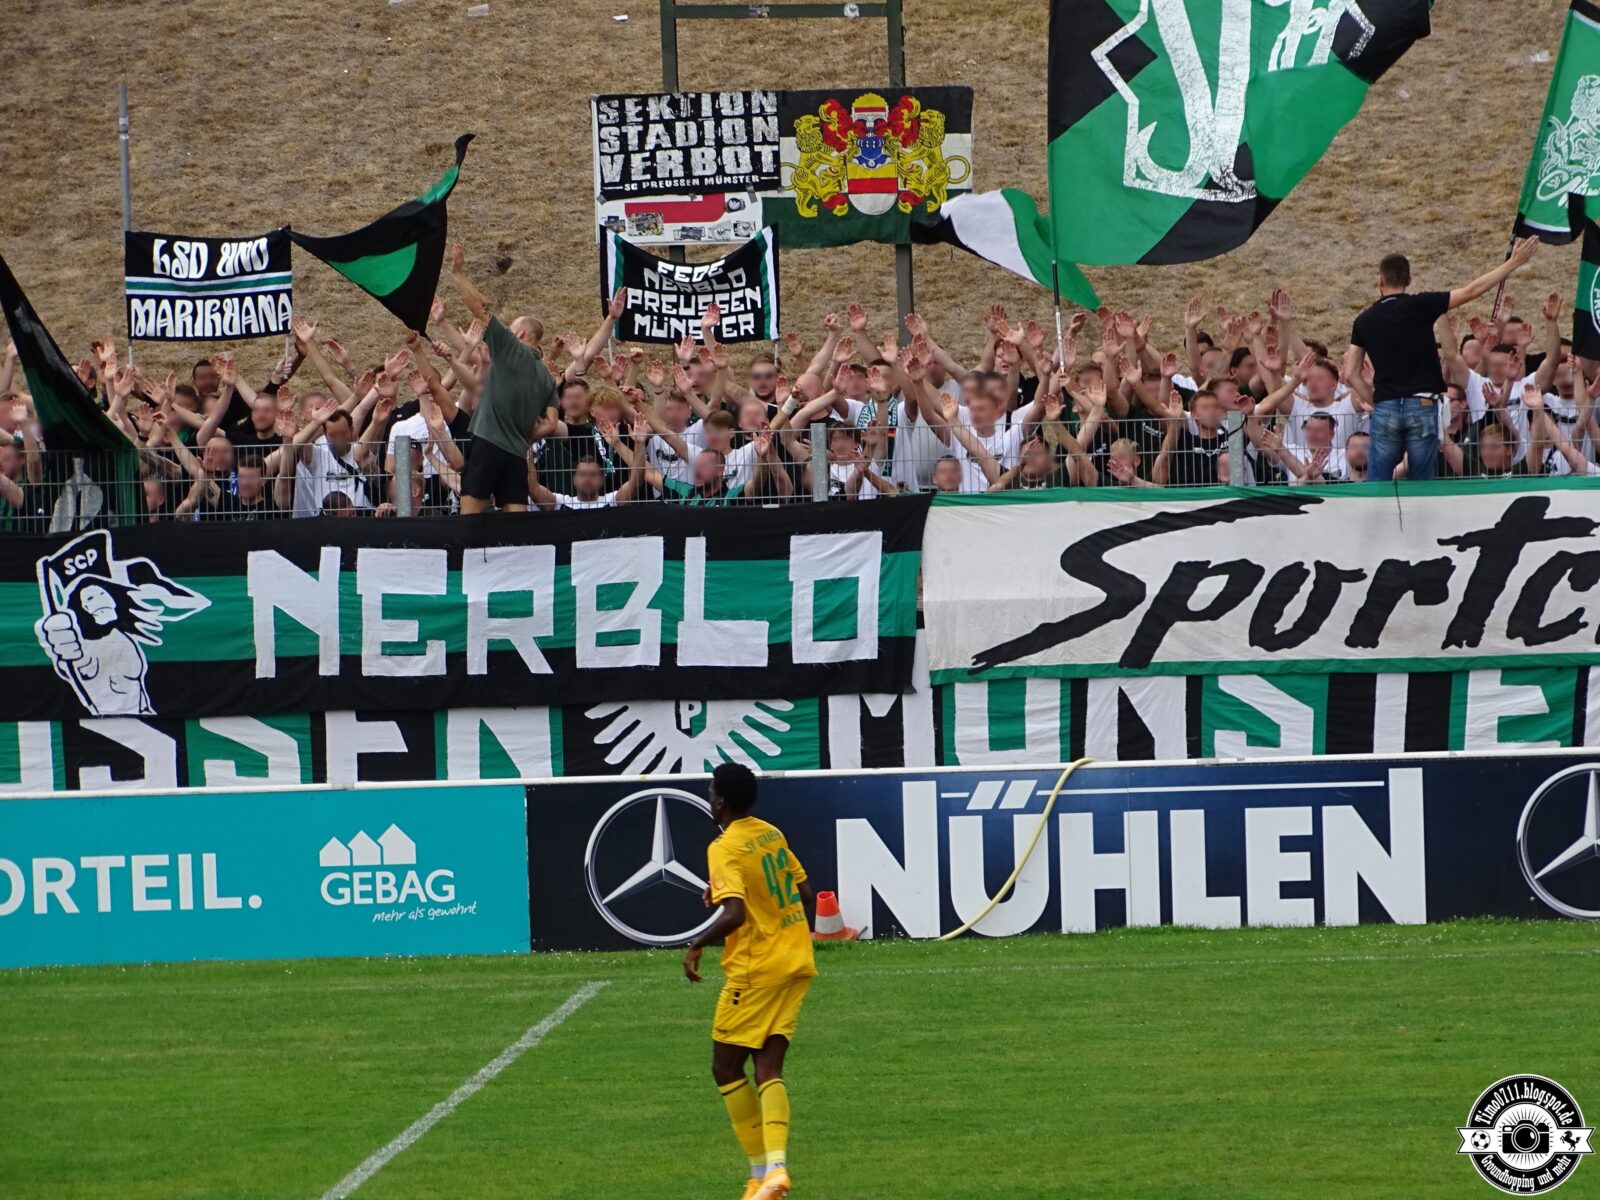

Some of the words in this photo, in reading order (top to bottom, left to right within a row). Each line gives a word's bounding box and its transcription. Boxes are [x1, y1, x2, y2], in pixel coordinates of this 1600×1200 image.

[599, 91, 777, 125] SEKTION
[600, 115, 779, 154] STADION
[601, 145, 779, 184] VERBOT
[642, 178, 700, 189] PREUSSEN
[704, 175, 760, 186] MÜNSTER
[153, 238, 208, 279] LSD
[657, 259, 726, 283] FEDE
[643, 267, 747, 293] NERBLO
[627, 286, 762, 316] PREUSSEN
[63, 548, 98, 576] SCP
[967, 494, 1600, 674] Sportc
[246, 529, 882, 679] NERBLO
[836, 767, 1427, 939] NÜHLEN
[320, 869, 456, 906] GEBAG
[761, 847, 803, 910] 42
[372, 909, 404, 923] mehr
[408, 907, 424, 921] als
[427, 900, 477, 921] gewohnt
